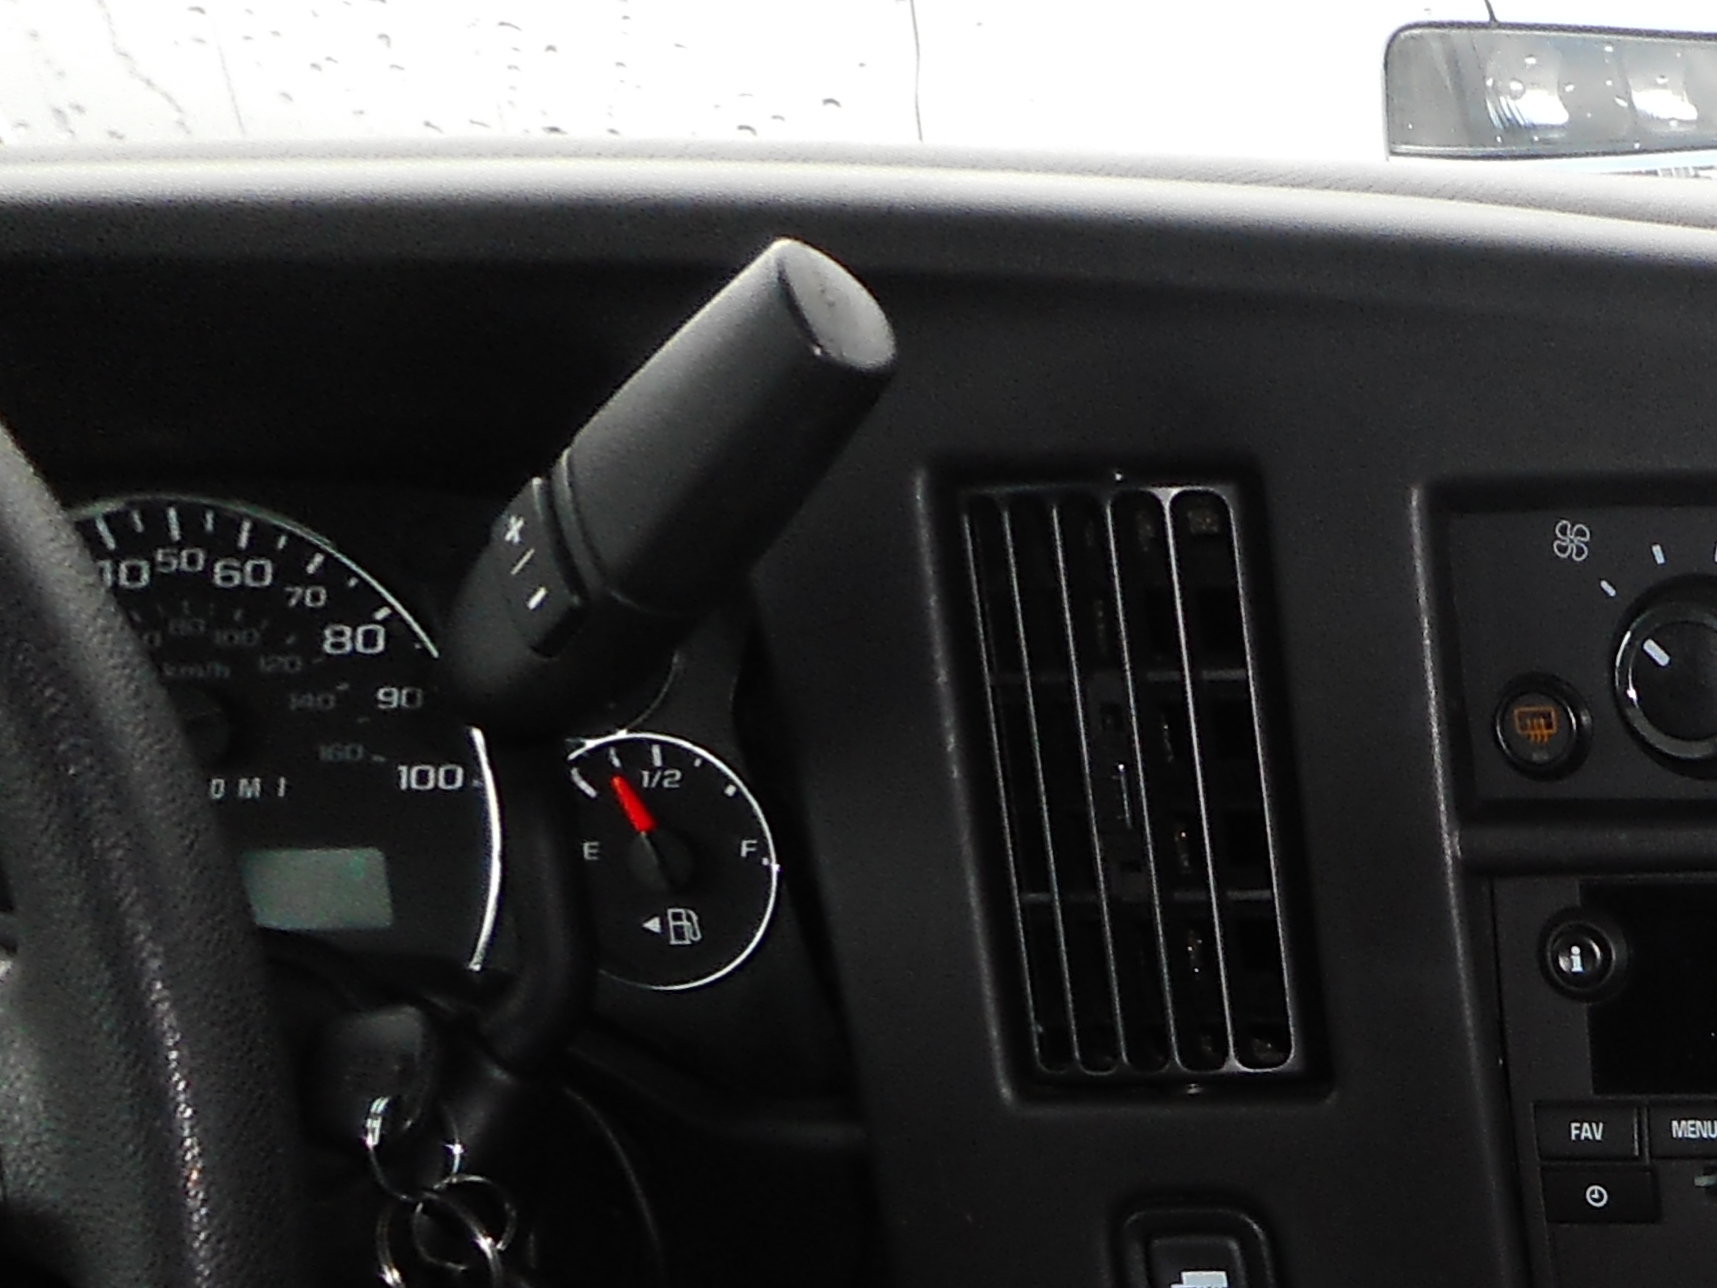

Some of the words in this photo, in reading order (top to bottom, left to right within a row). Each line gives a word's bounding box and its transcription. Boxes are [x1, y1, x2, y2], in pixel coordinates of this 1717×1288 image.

[155, 547, 206, 573] 50
[213, 558, 273, 588] 60
[285, 585, 328, 608] 70
[322, 624, 386, 655] 80
[376, 687, 422, 711] 90
[397, 764, 464, 790] 100
[641, 769, 683, 788] 1/2
[582, 841, 600, 860] E
[740, 839, 758, 858] F
[1570, 1122, 1604, 1141] FAV
